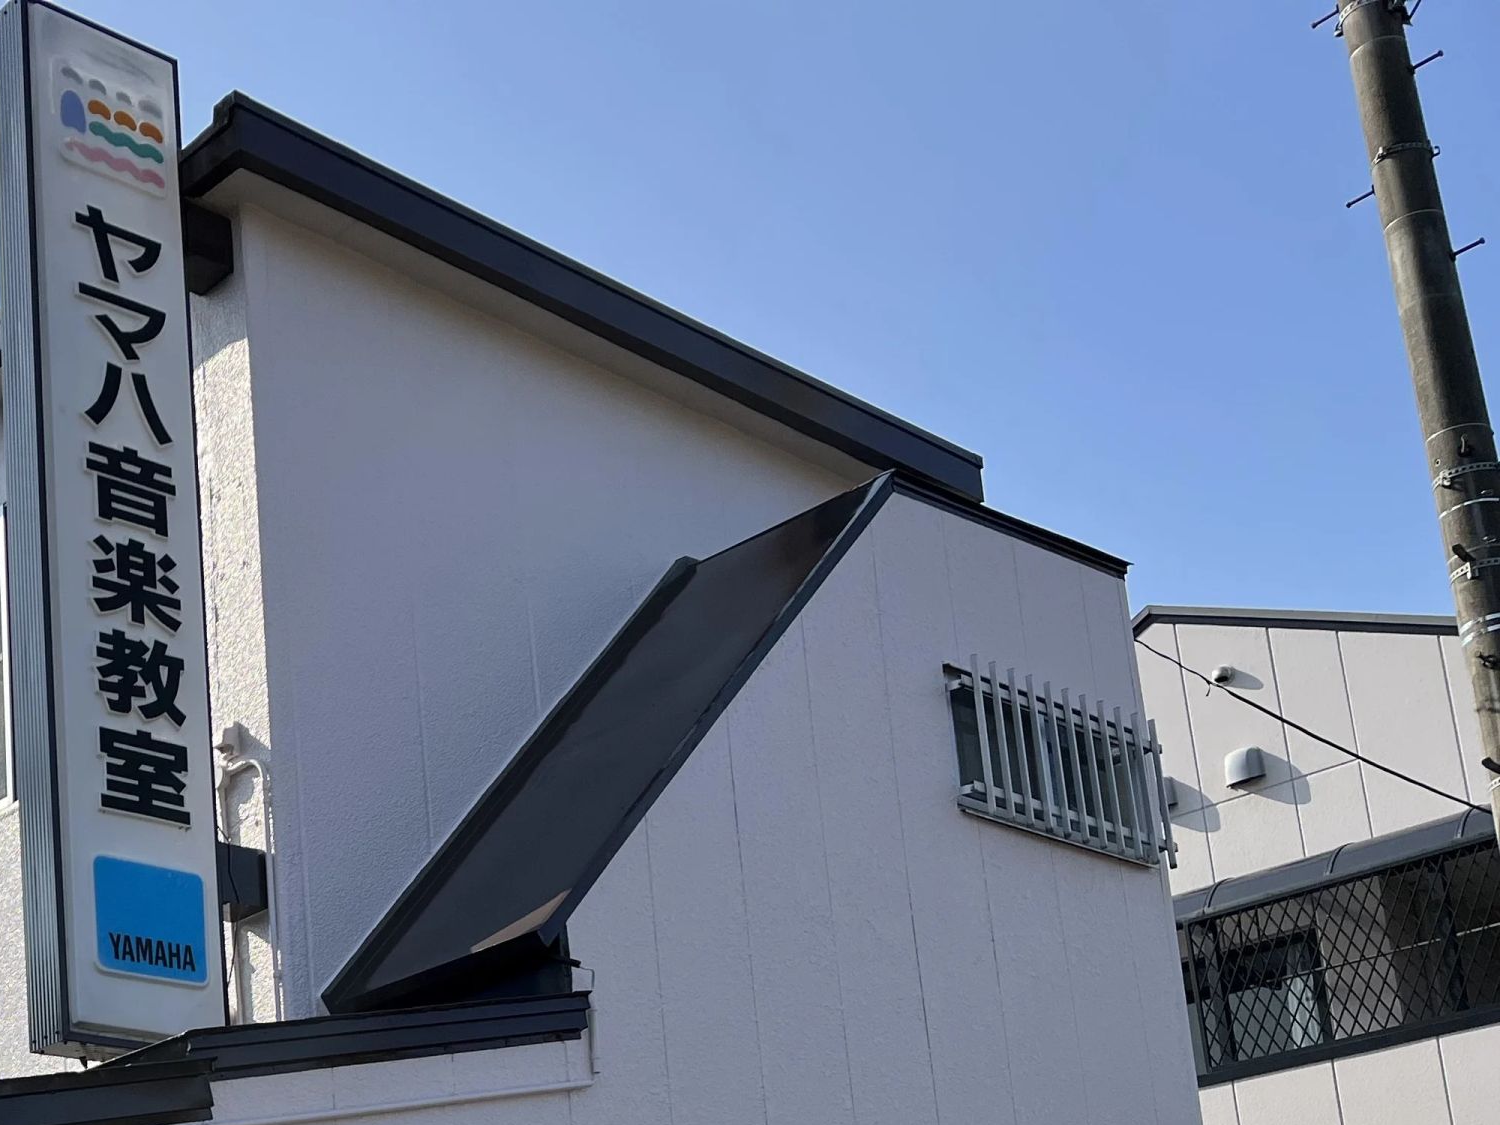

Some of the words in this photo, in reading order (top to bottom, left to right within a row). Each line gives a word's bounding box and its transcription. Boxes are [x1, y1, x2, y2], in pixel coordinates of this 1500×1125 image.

[75, 206, 192, 827] ヤマハ音楽教室
[108, 932, 196, 972] YAMAHA
